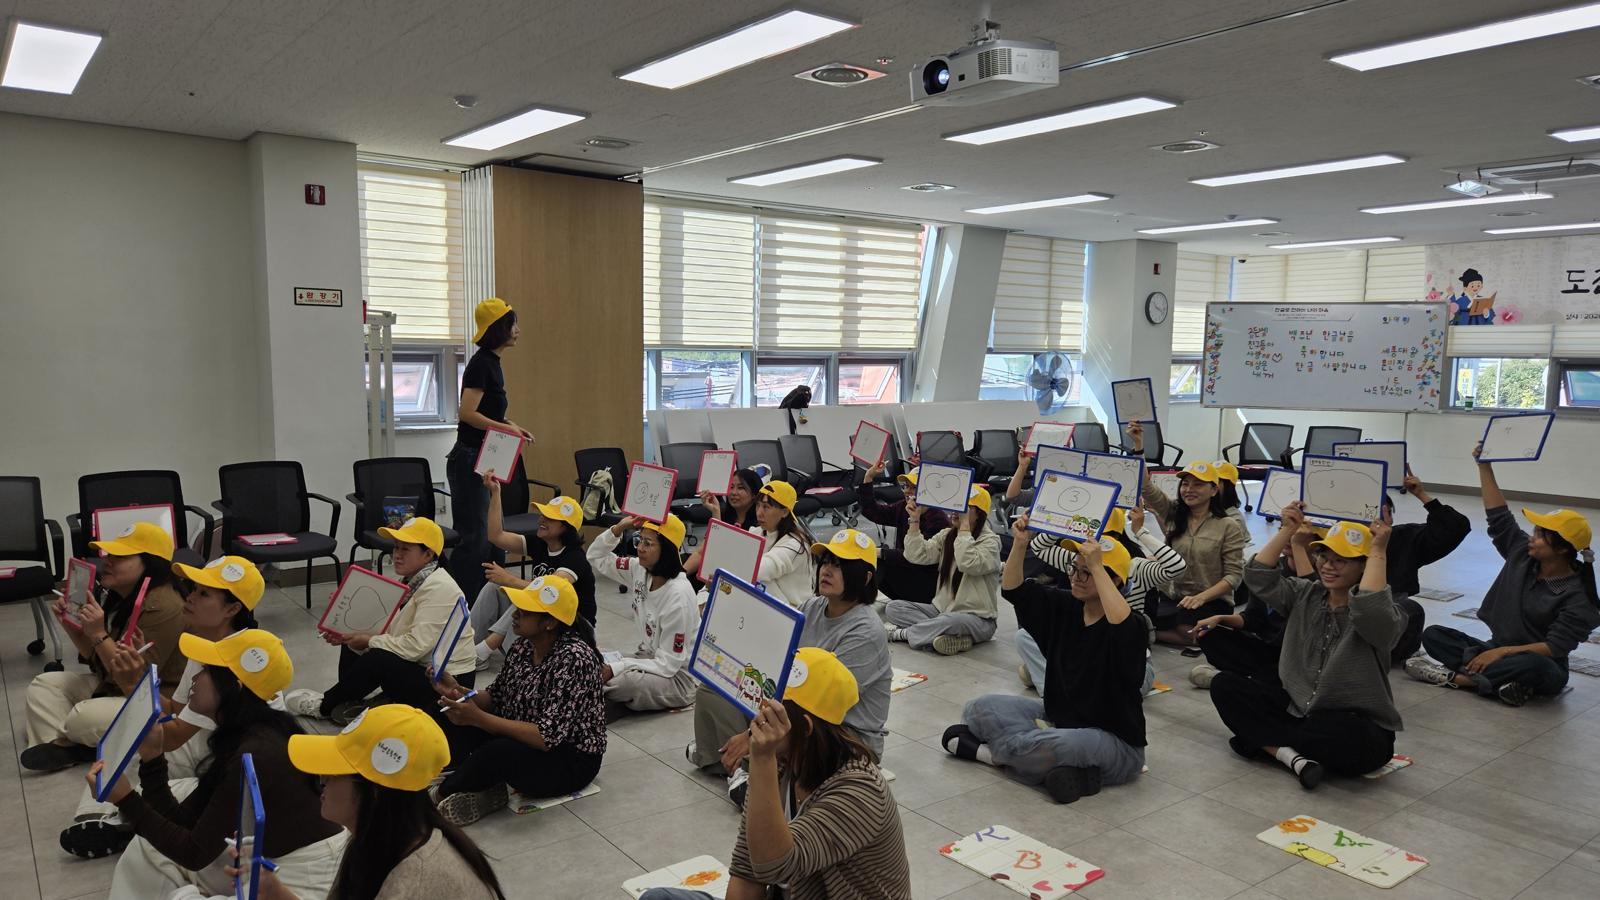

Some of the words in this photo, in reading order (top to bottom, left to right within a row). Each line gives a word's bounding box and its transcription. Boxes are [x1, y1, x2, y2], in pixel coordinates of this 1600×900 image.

[1382, 345, 1418, 358] 세종대왕
[1382, 359, 1413, 371] 훈민정음
[1070, 490, 1081, 503] 3
[738, 616, 744, 630] 3
